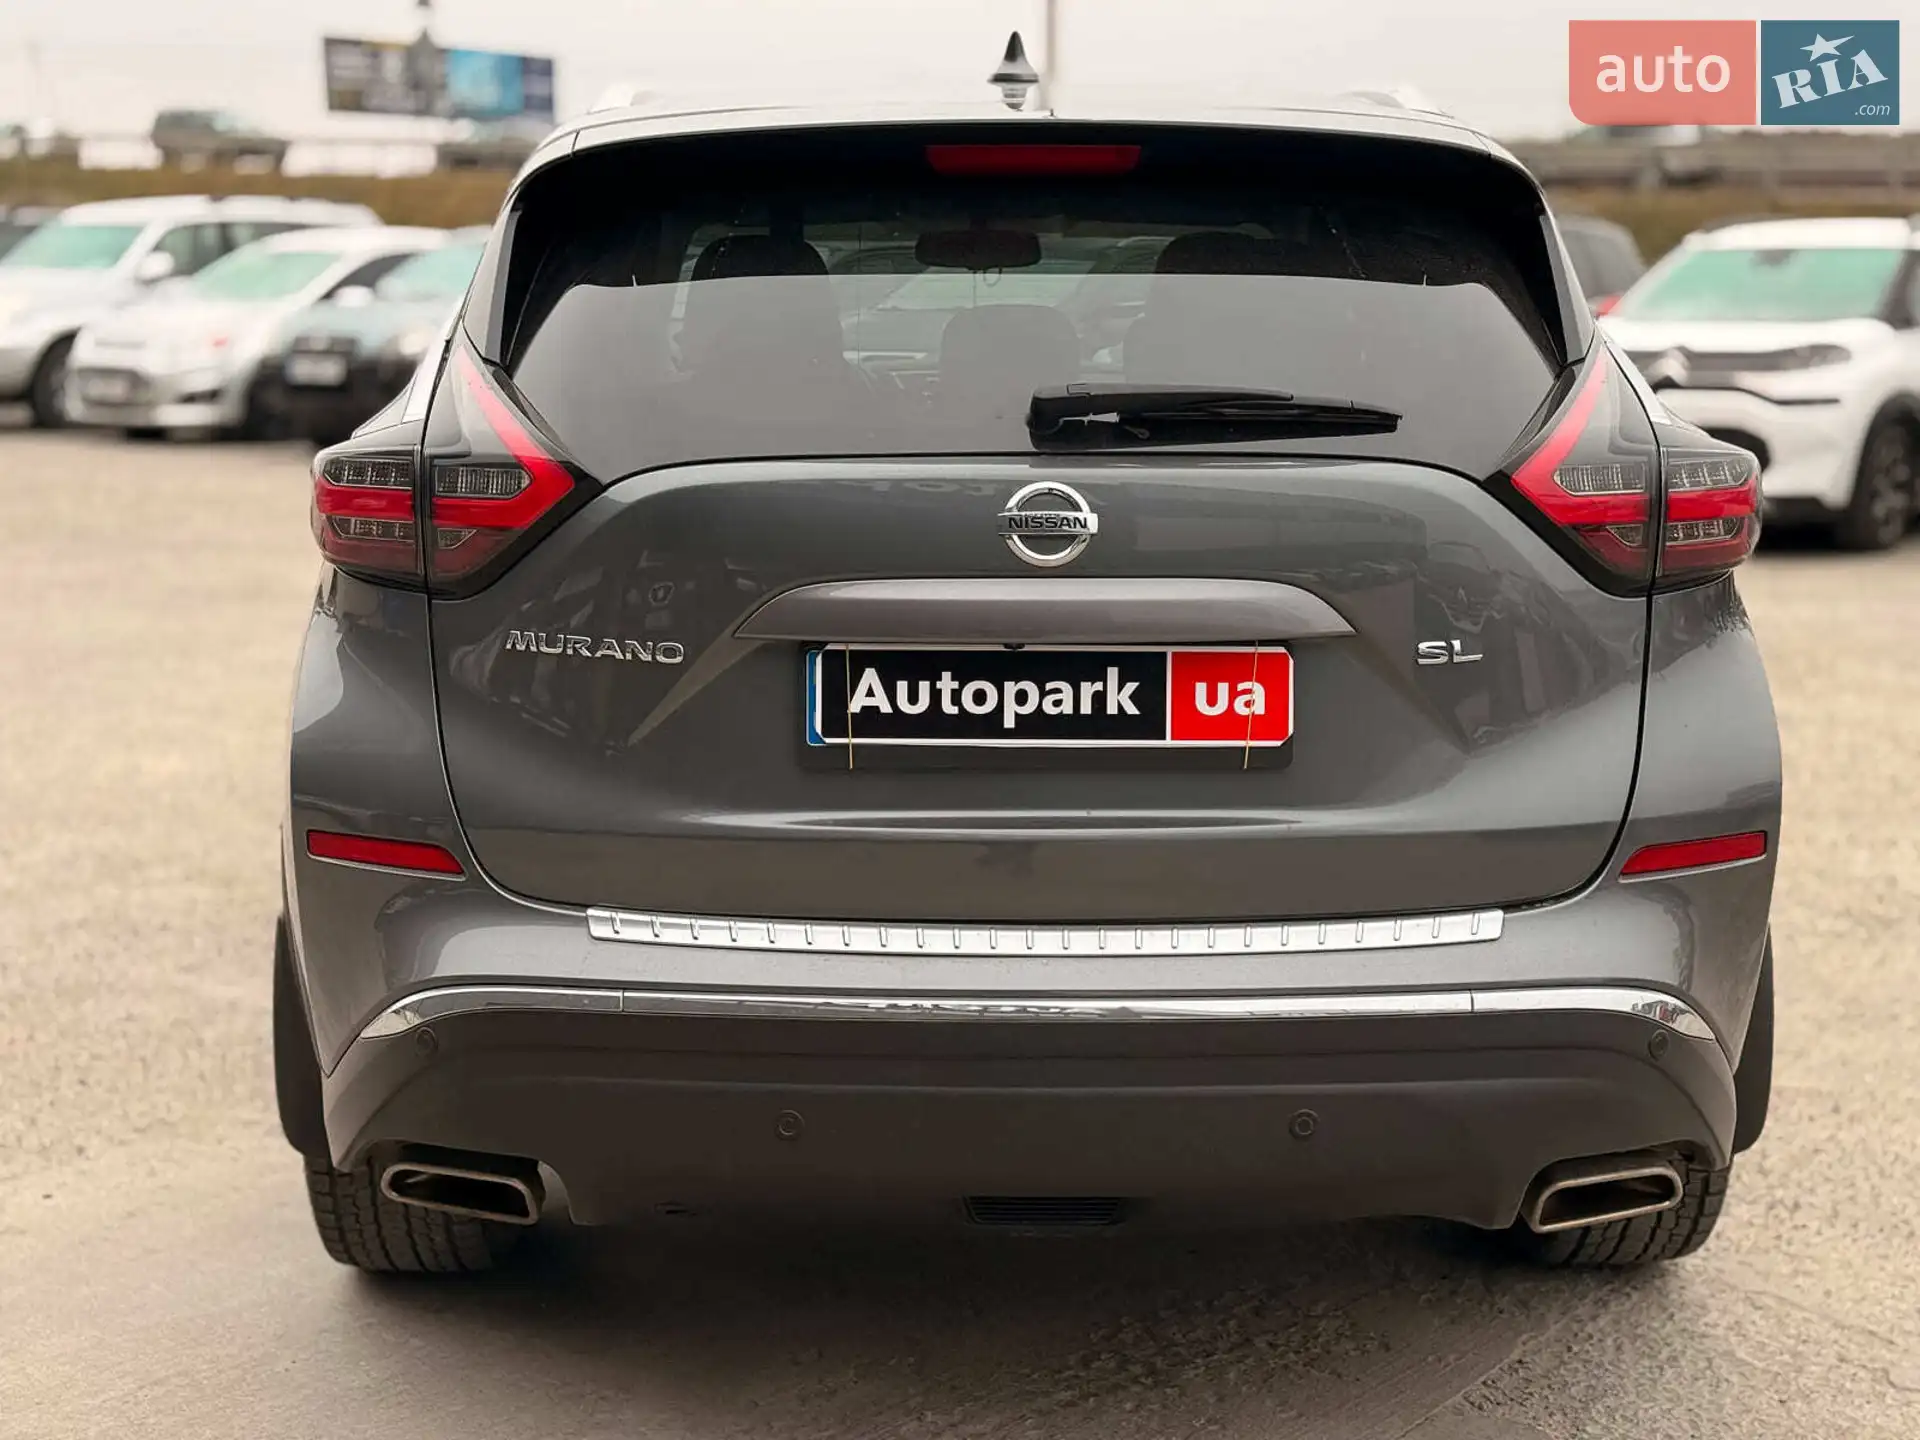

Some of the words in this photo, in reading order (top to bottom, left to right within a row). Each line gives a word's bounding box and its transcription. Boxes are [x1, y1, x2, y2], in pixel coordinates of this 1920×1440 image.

[1008, 516, 1088, 529] NISSAN
[505, 630, 684, 664] MURANO
[1416, 639, 1484, 665] SL
[848, 666, 1141, 729] Autopark
[1194, 681, 1266, 716] ua
